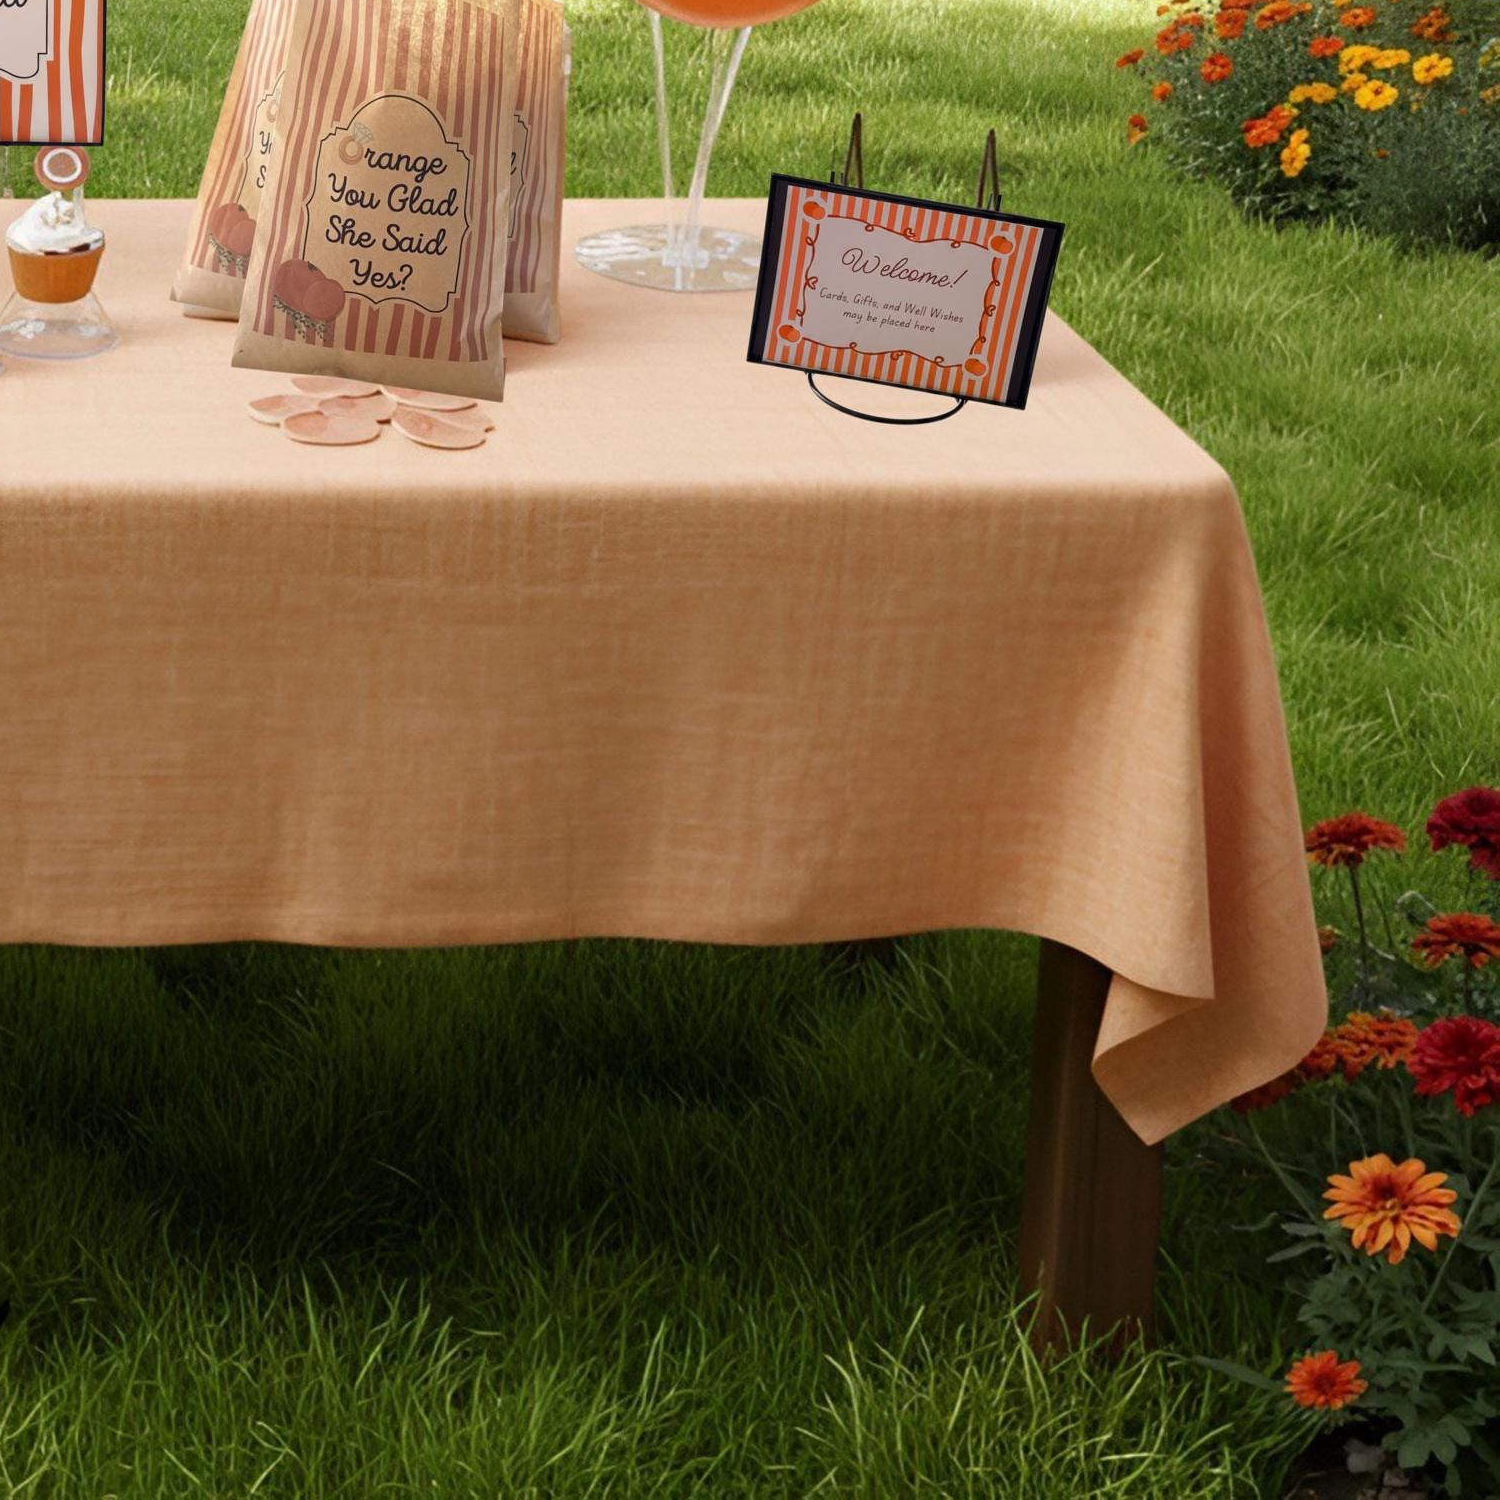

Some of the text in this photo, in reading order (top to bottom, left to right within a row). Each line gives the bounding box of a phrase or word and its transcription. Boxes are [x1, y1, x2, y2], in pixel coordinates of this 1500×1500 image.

[328, 172, 459, 216] You Glad
[325, 214, 448, 255] She Said
[349, 258, 414, 291] Yes?
[841, 247, 968, 288] Welcome!
[842, 310, 936, 333] may be placed here
[882, 301, 901, 312] and
[904, 302, 927, 316] Well
[930, 307, 964, 324] Wishes
